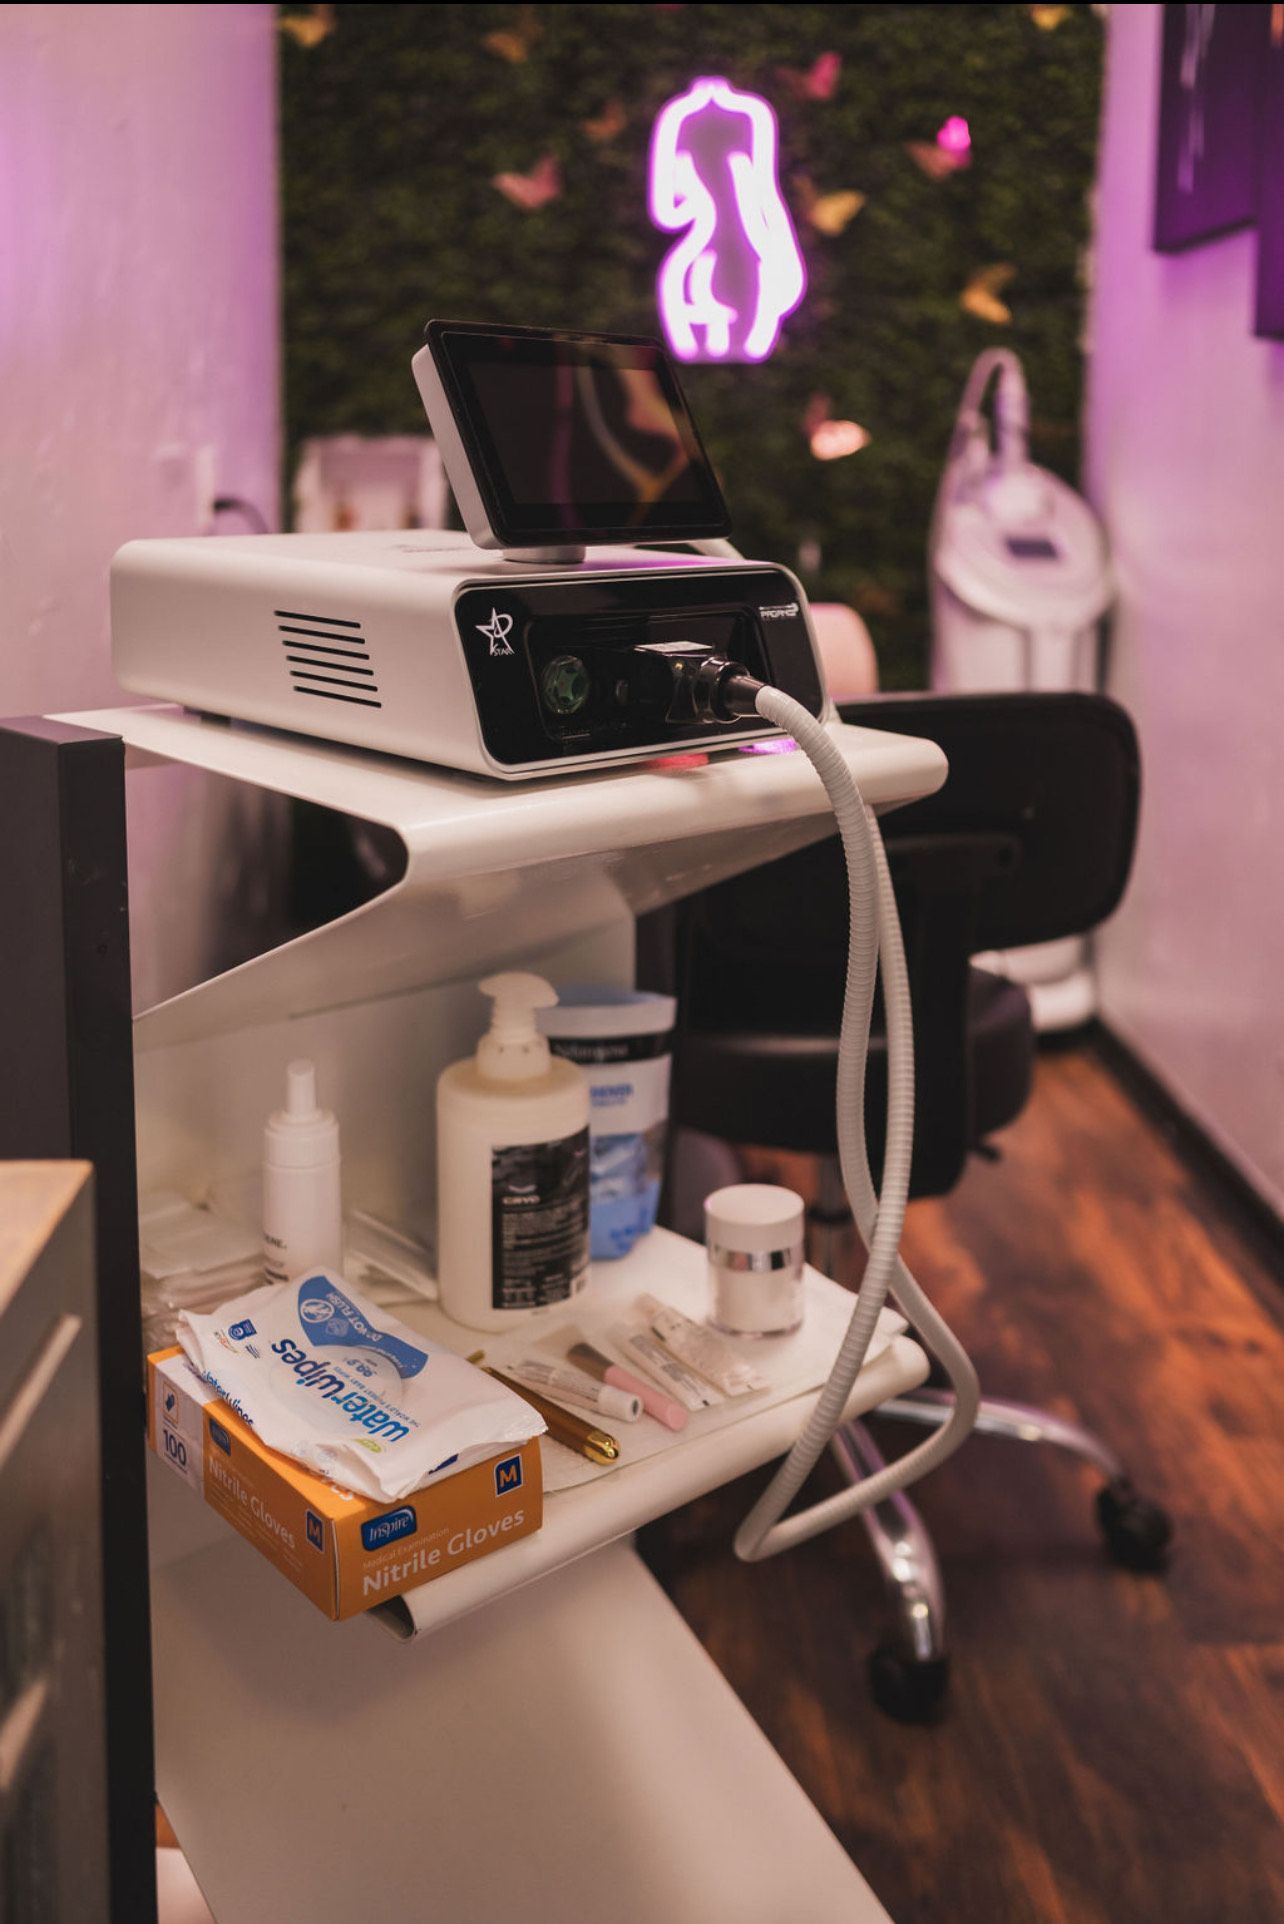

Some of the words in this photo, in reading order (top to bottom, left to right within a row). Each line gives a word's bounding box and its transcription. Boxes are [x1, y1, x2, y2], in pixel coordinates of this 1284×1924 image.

[162, 1428, 188, 1467] 100
[500, 1464, 518, 1488] M
[208, 1455, 248, 1507] Nitrile
[250, 1495, 296, 1550] Gloves
[368, 1515, 409, 1543] Inspire
[363, 1548, 441, 1596] Nitrile
[447, 1509, 526, 1556] Gloves
